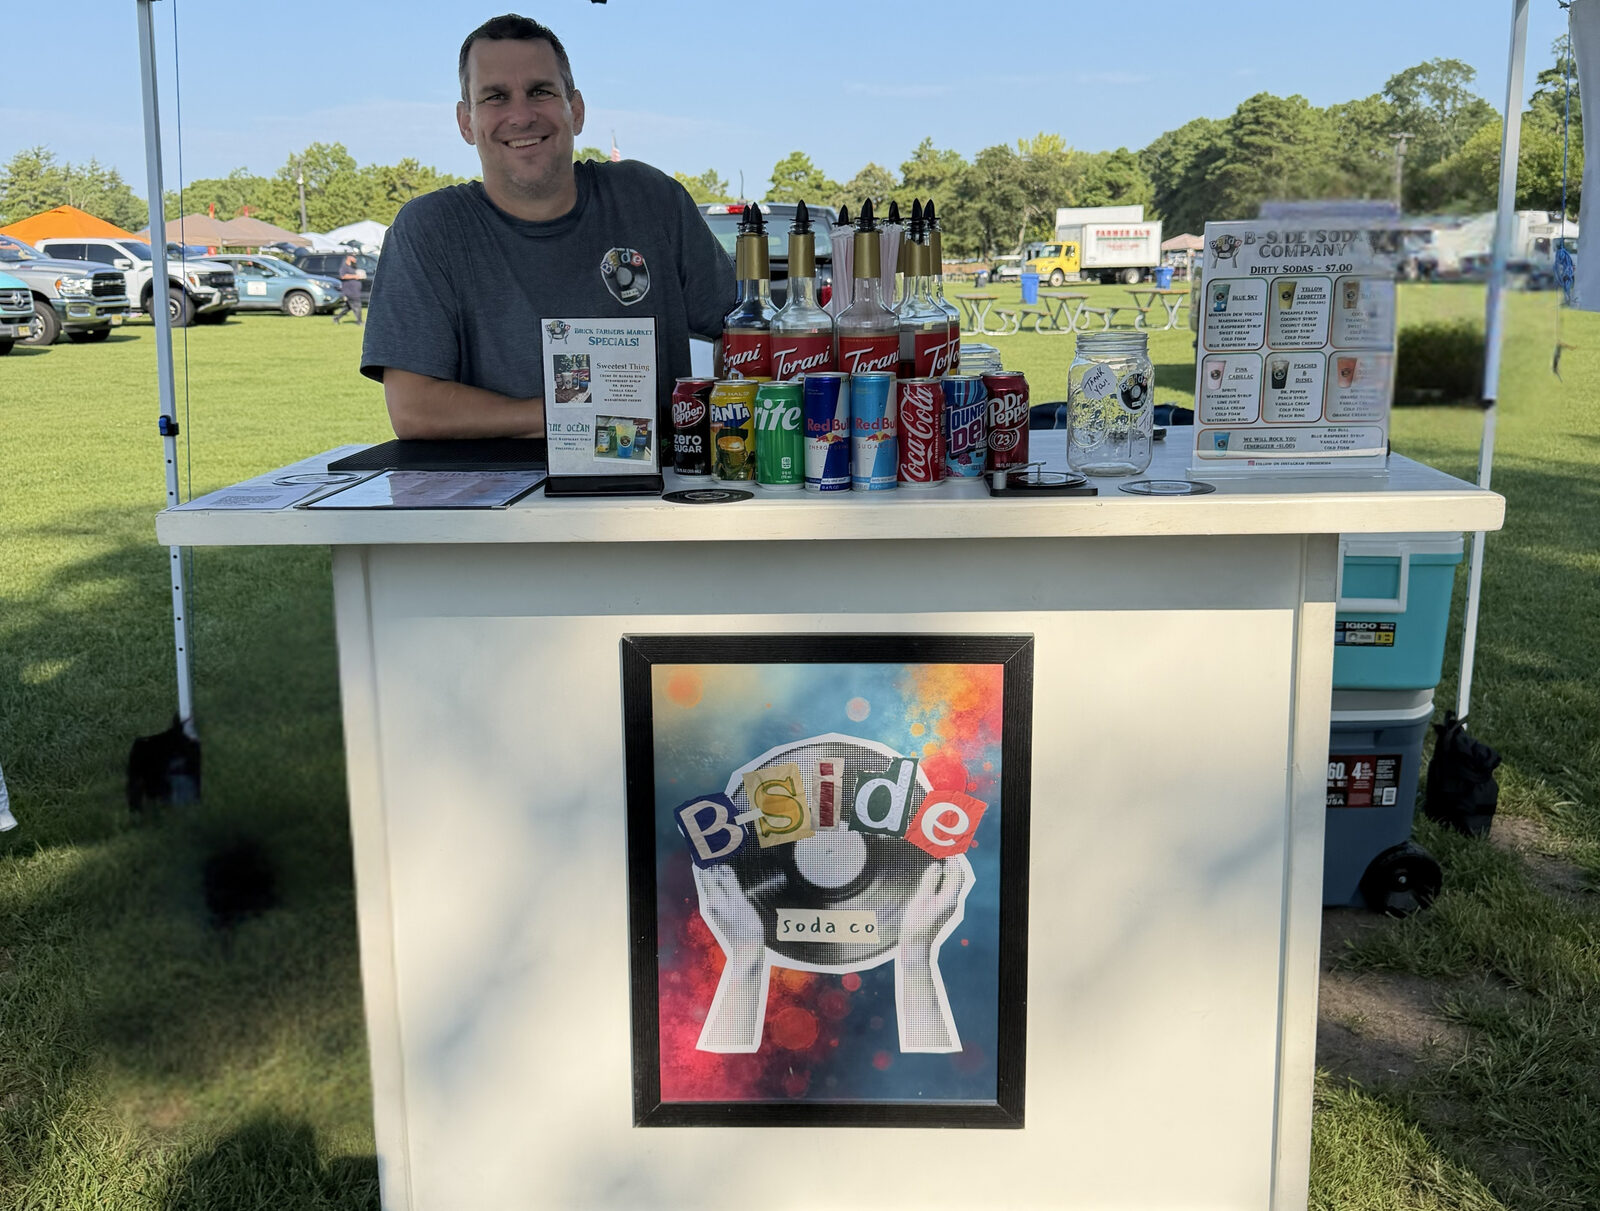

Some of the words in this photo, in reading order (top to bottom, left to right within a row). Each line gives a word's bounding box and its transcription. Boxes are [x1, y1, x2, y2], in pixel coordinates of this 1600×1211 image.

[1259, 244, 1346, 258] COMPANY
[1250, 266, 1278, 274] DIRTY
[1282, 264, 1314, 273] SODAS
[1325, 263, 1353, 272] $7.00
[589, 337, 639, 346] SPECIALS!
[774, 346, 831, 380] Torani
[845, 345, 900, 373] Torani
[1004, 393, 1023, 406] Dr
[679, 401, 693, 412] Dr
[711, 404, 750, 421] FANTA
[672, 404, 702, 424] Pepper
[548, 422, 561, 432] THE
[567, 422, 590, 432] OCEAN
[808, 418, 830, 431] Red
[856, 418, 879, 430] Red
[900, 384, 934, 482] Coca-Cola
[997, 434, 1010, 445] 23
[674, 435, 702, 445] zero
[674, 445, 702, 453] SUGAR
[1328, 762, 1345, 779] 60
[1352, 762, 1362, 779] 4
[783, 916, 836, 933] soda
[850, 922, 876, 934] co
